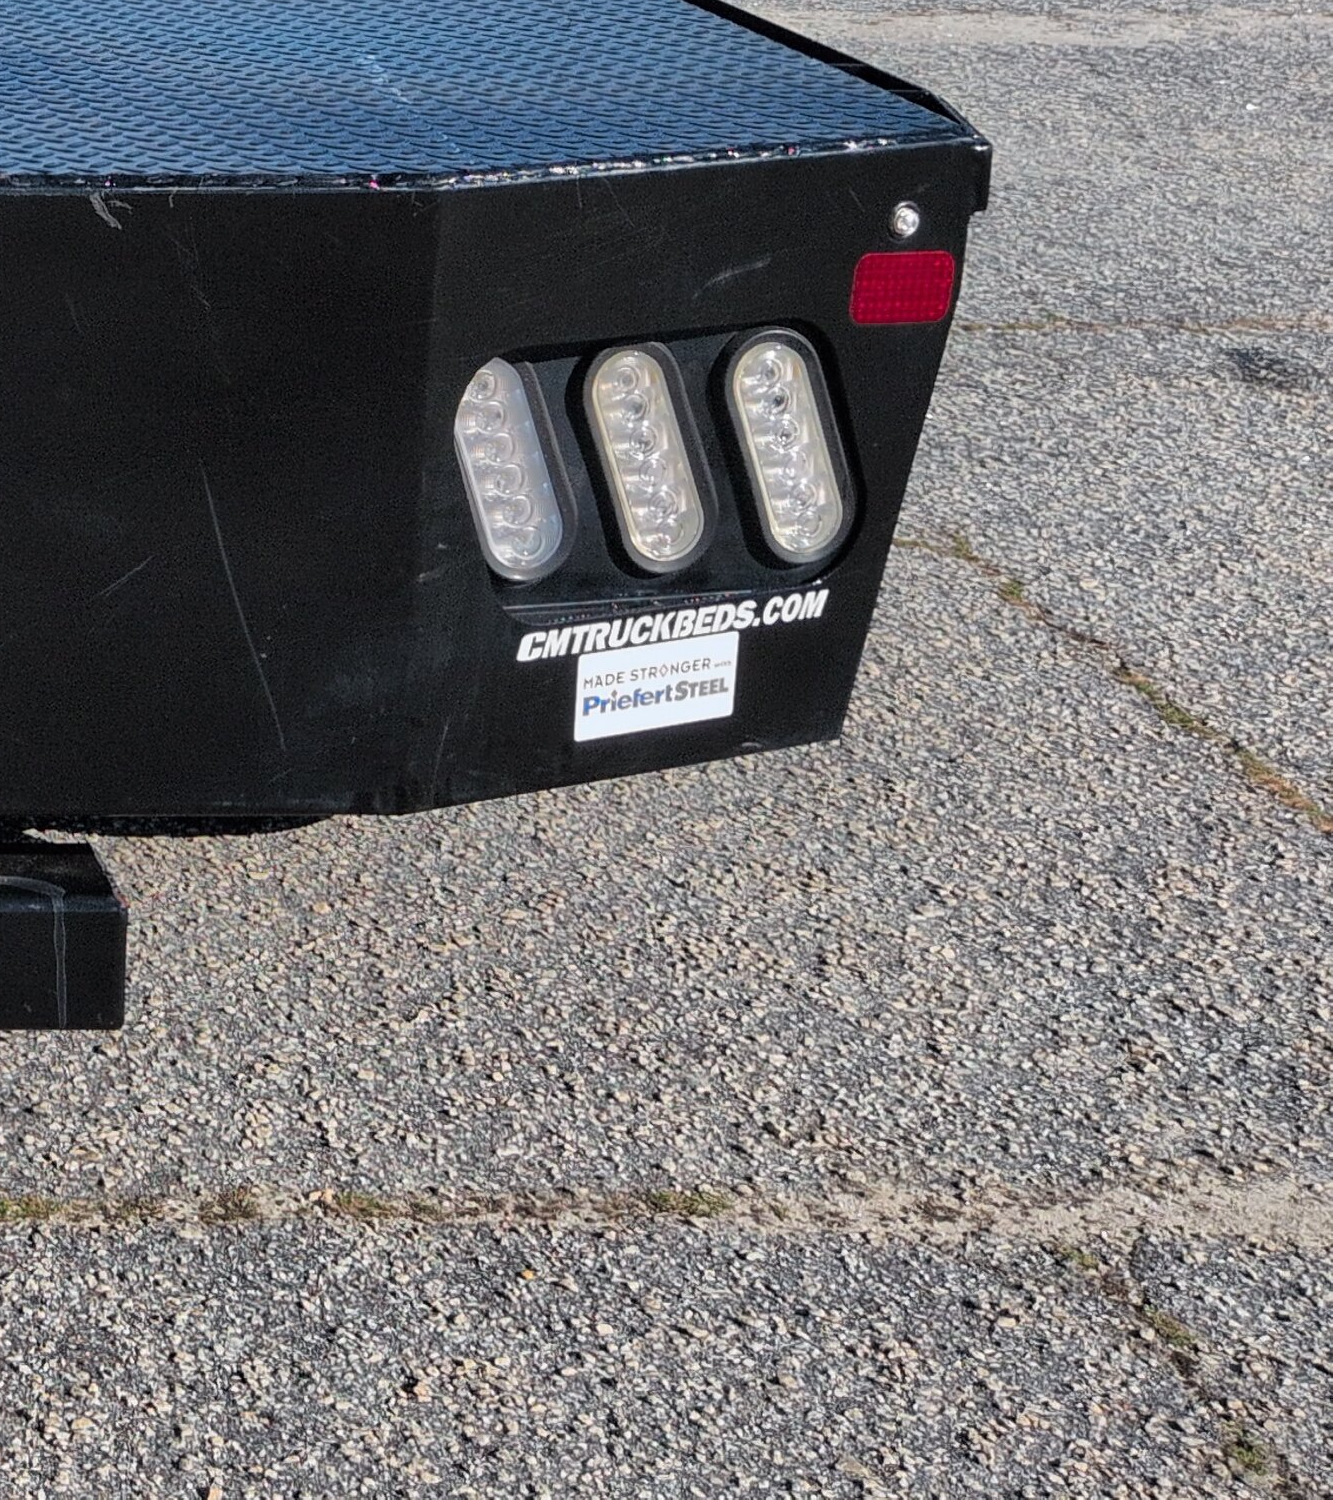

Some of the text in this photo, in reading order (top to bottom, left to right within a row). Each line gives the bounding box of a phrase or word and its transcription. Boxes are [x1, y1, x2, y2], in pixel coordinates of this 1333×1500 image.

[516, 588, 830, 662] CMTRUCKBEDS.COM
[583, 671, 626, 690] MADE
[630, 657, 712, 682] STRONGER
